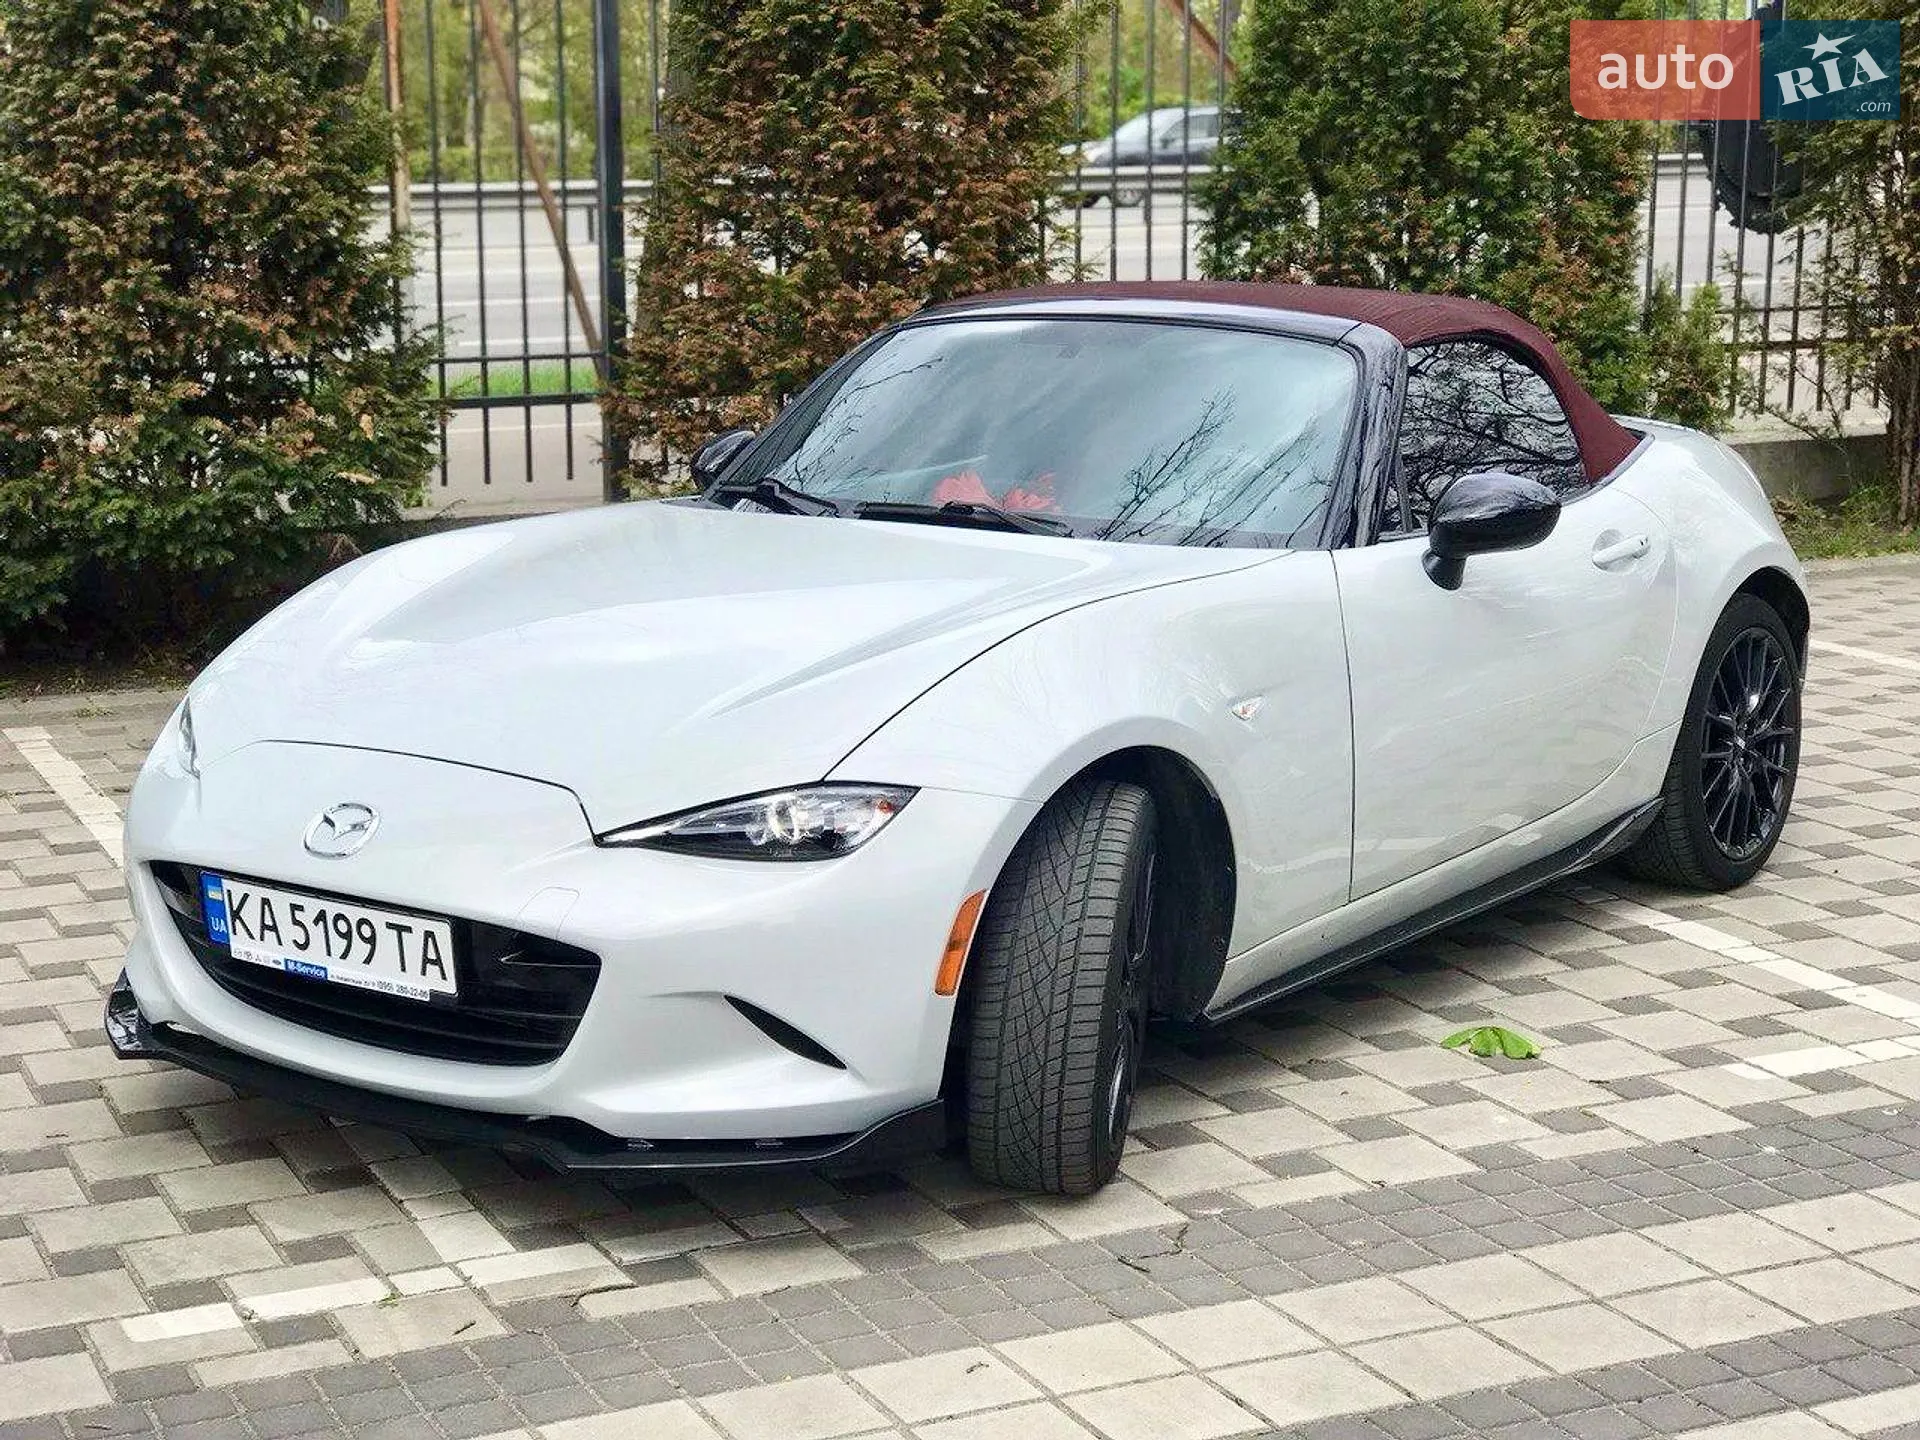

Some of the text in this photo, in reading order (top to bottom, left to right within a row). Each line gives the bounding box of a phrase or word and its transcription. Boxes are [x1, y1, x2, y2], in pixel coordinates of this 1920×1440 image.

[211, 917, 228, 932] UA
[227, 889, 448, 981] KA 5199 TA
